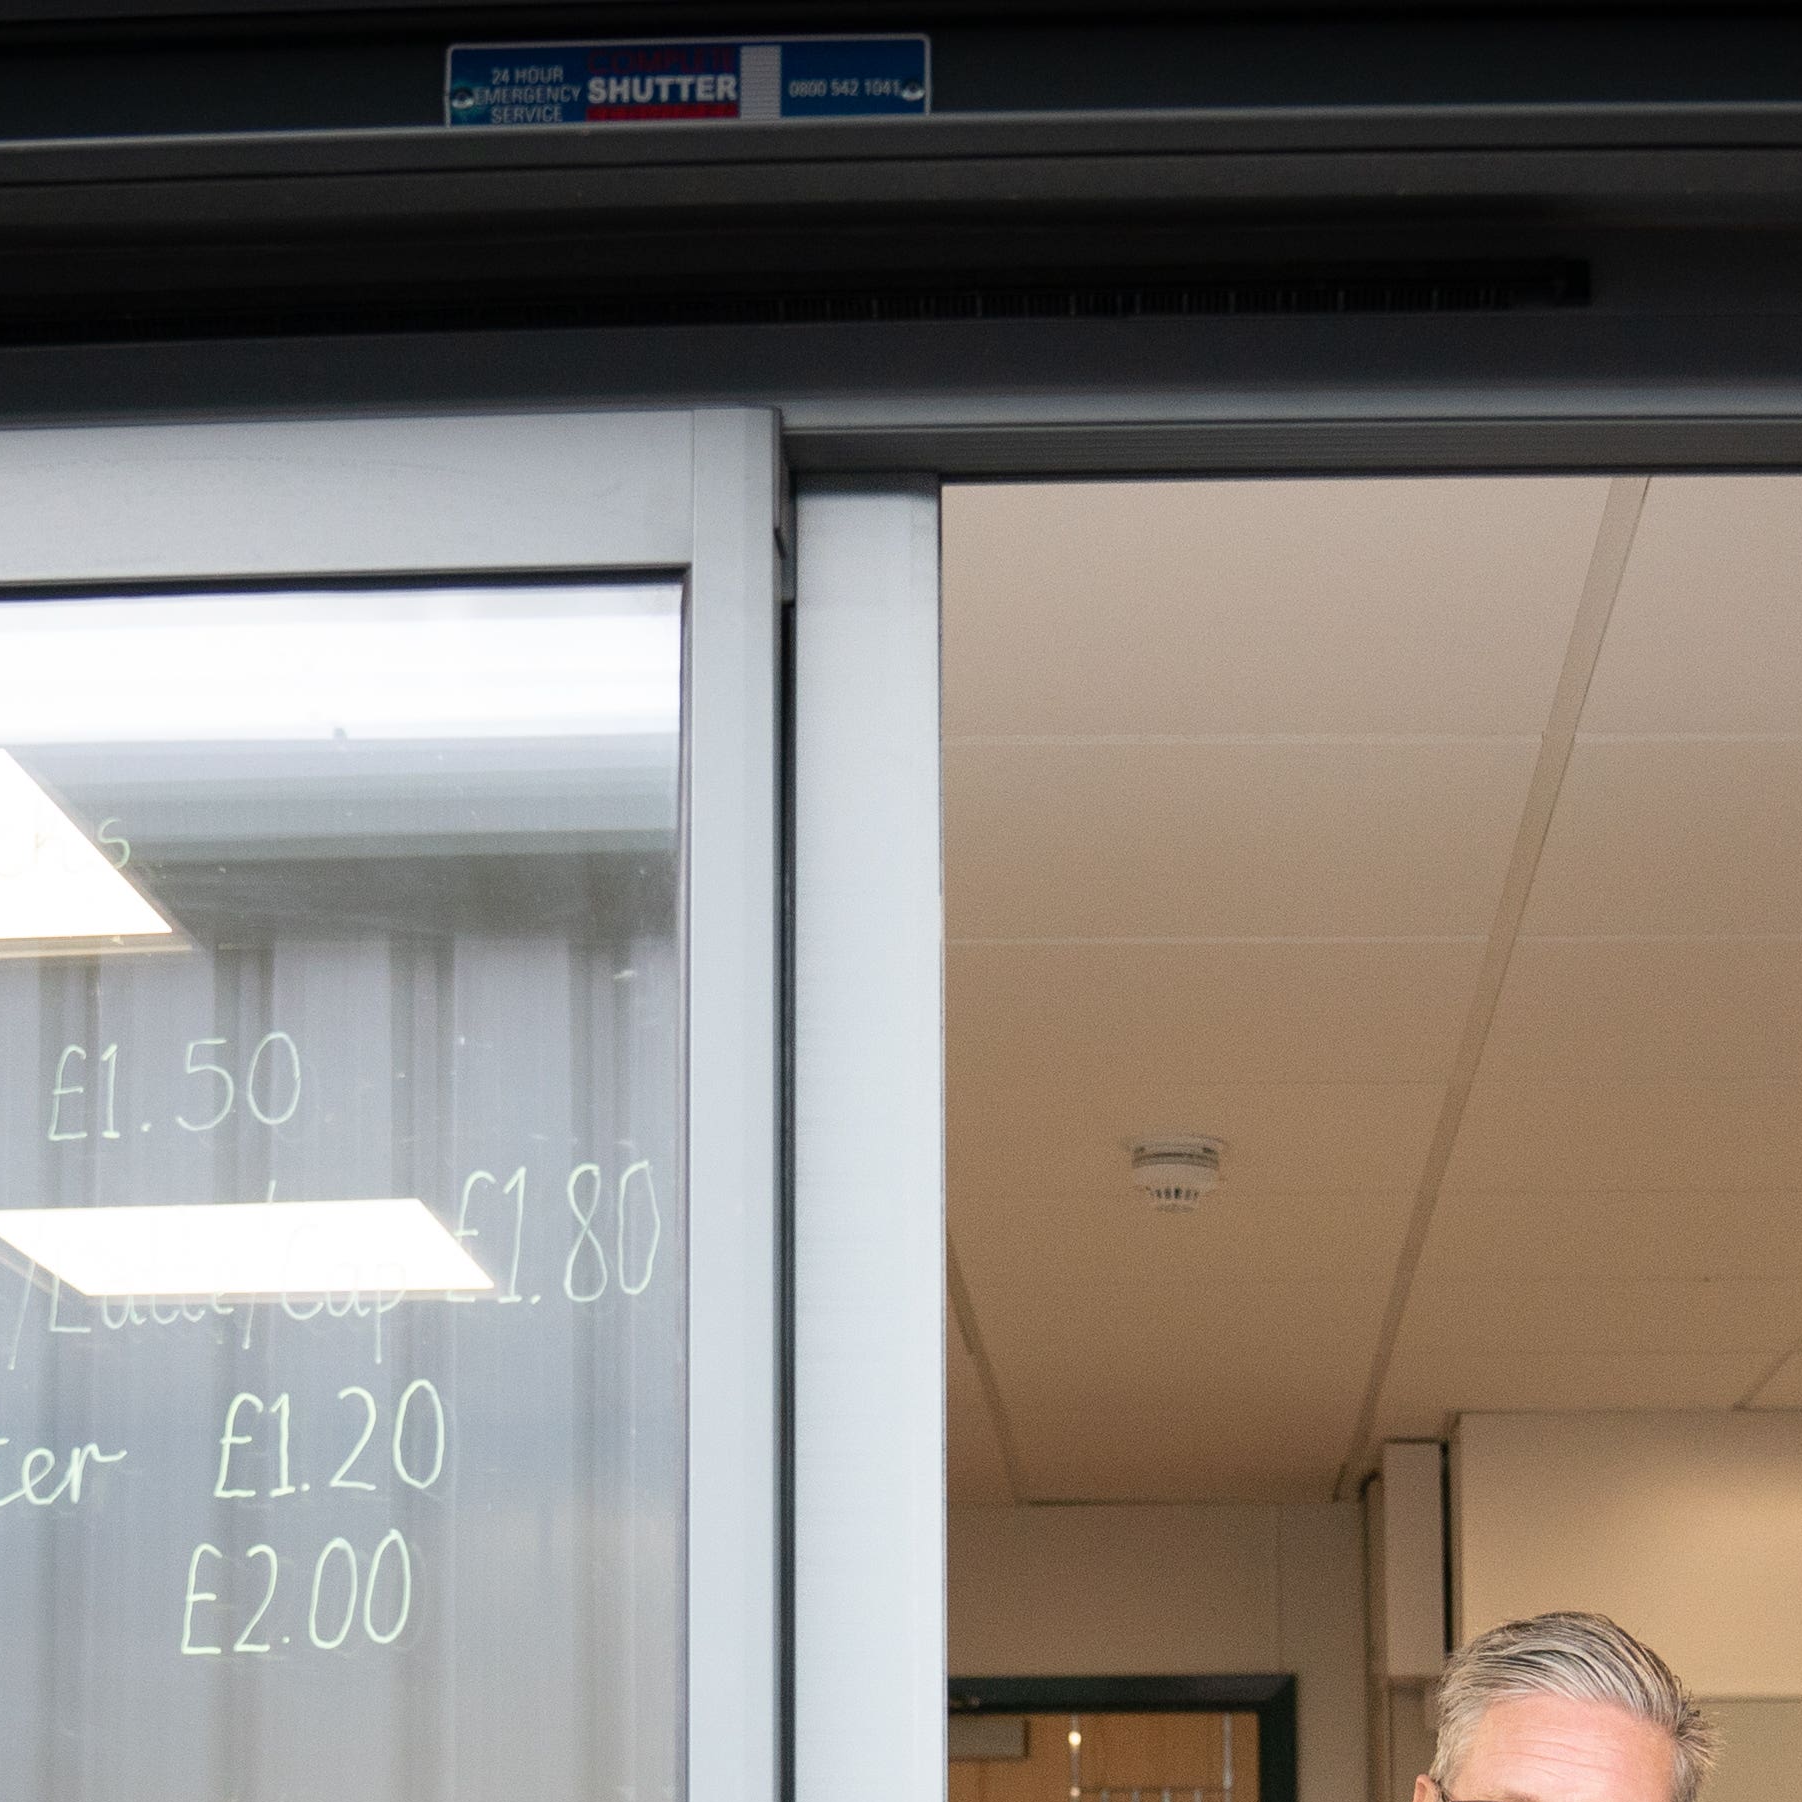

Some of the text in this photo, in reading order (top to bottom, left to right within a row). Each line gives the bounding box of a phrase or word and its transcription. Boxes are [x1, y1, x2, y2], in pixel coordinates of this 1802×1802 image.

[473, 85, 581, 104] EMERGENCY
[492, 65, 564, 84] 24 HOUR
[588, 74, 737, 104] SHUTTER
[491, 104, 563, 123] SERVICE
[48, 1031, 303, 1144] £1.50
[443, 1160, 661, 1307] £1.80
[213, 1378, 446, 1500] £1.20
[181, 1528, 413, 1656] £2.00
